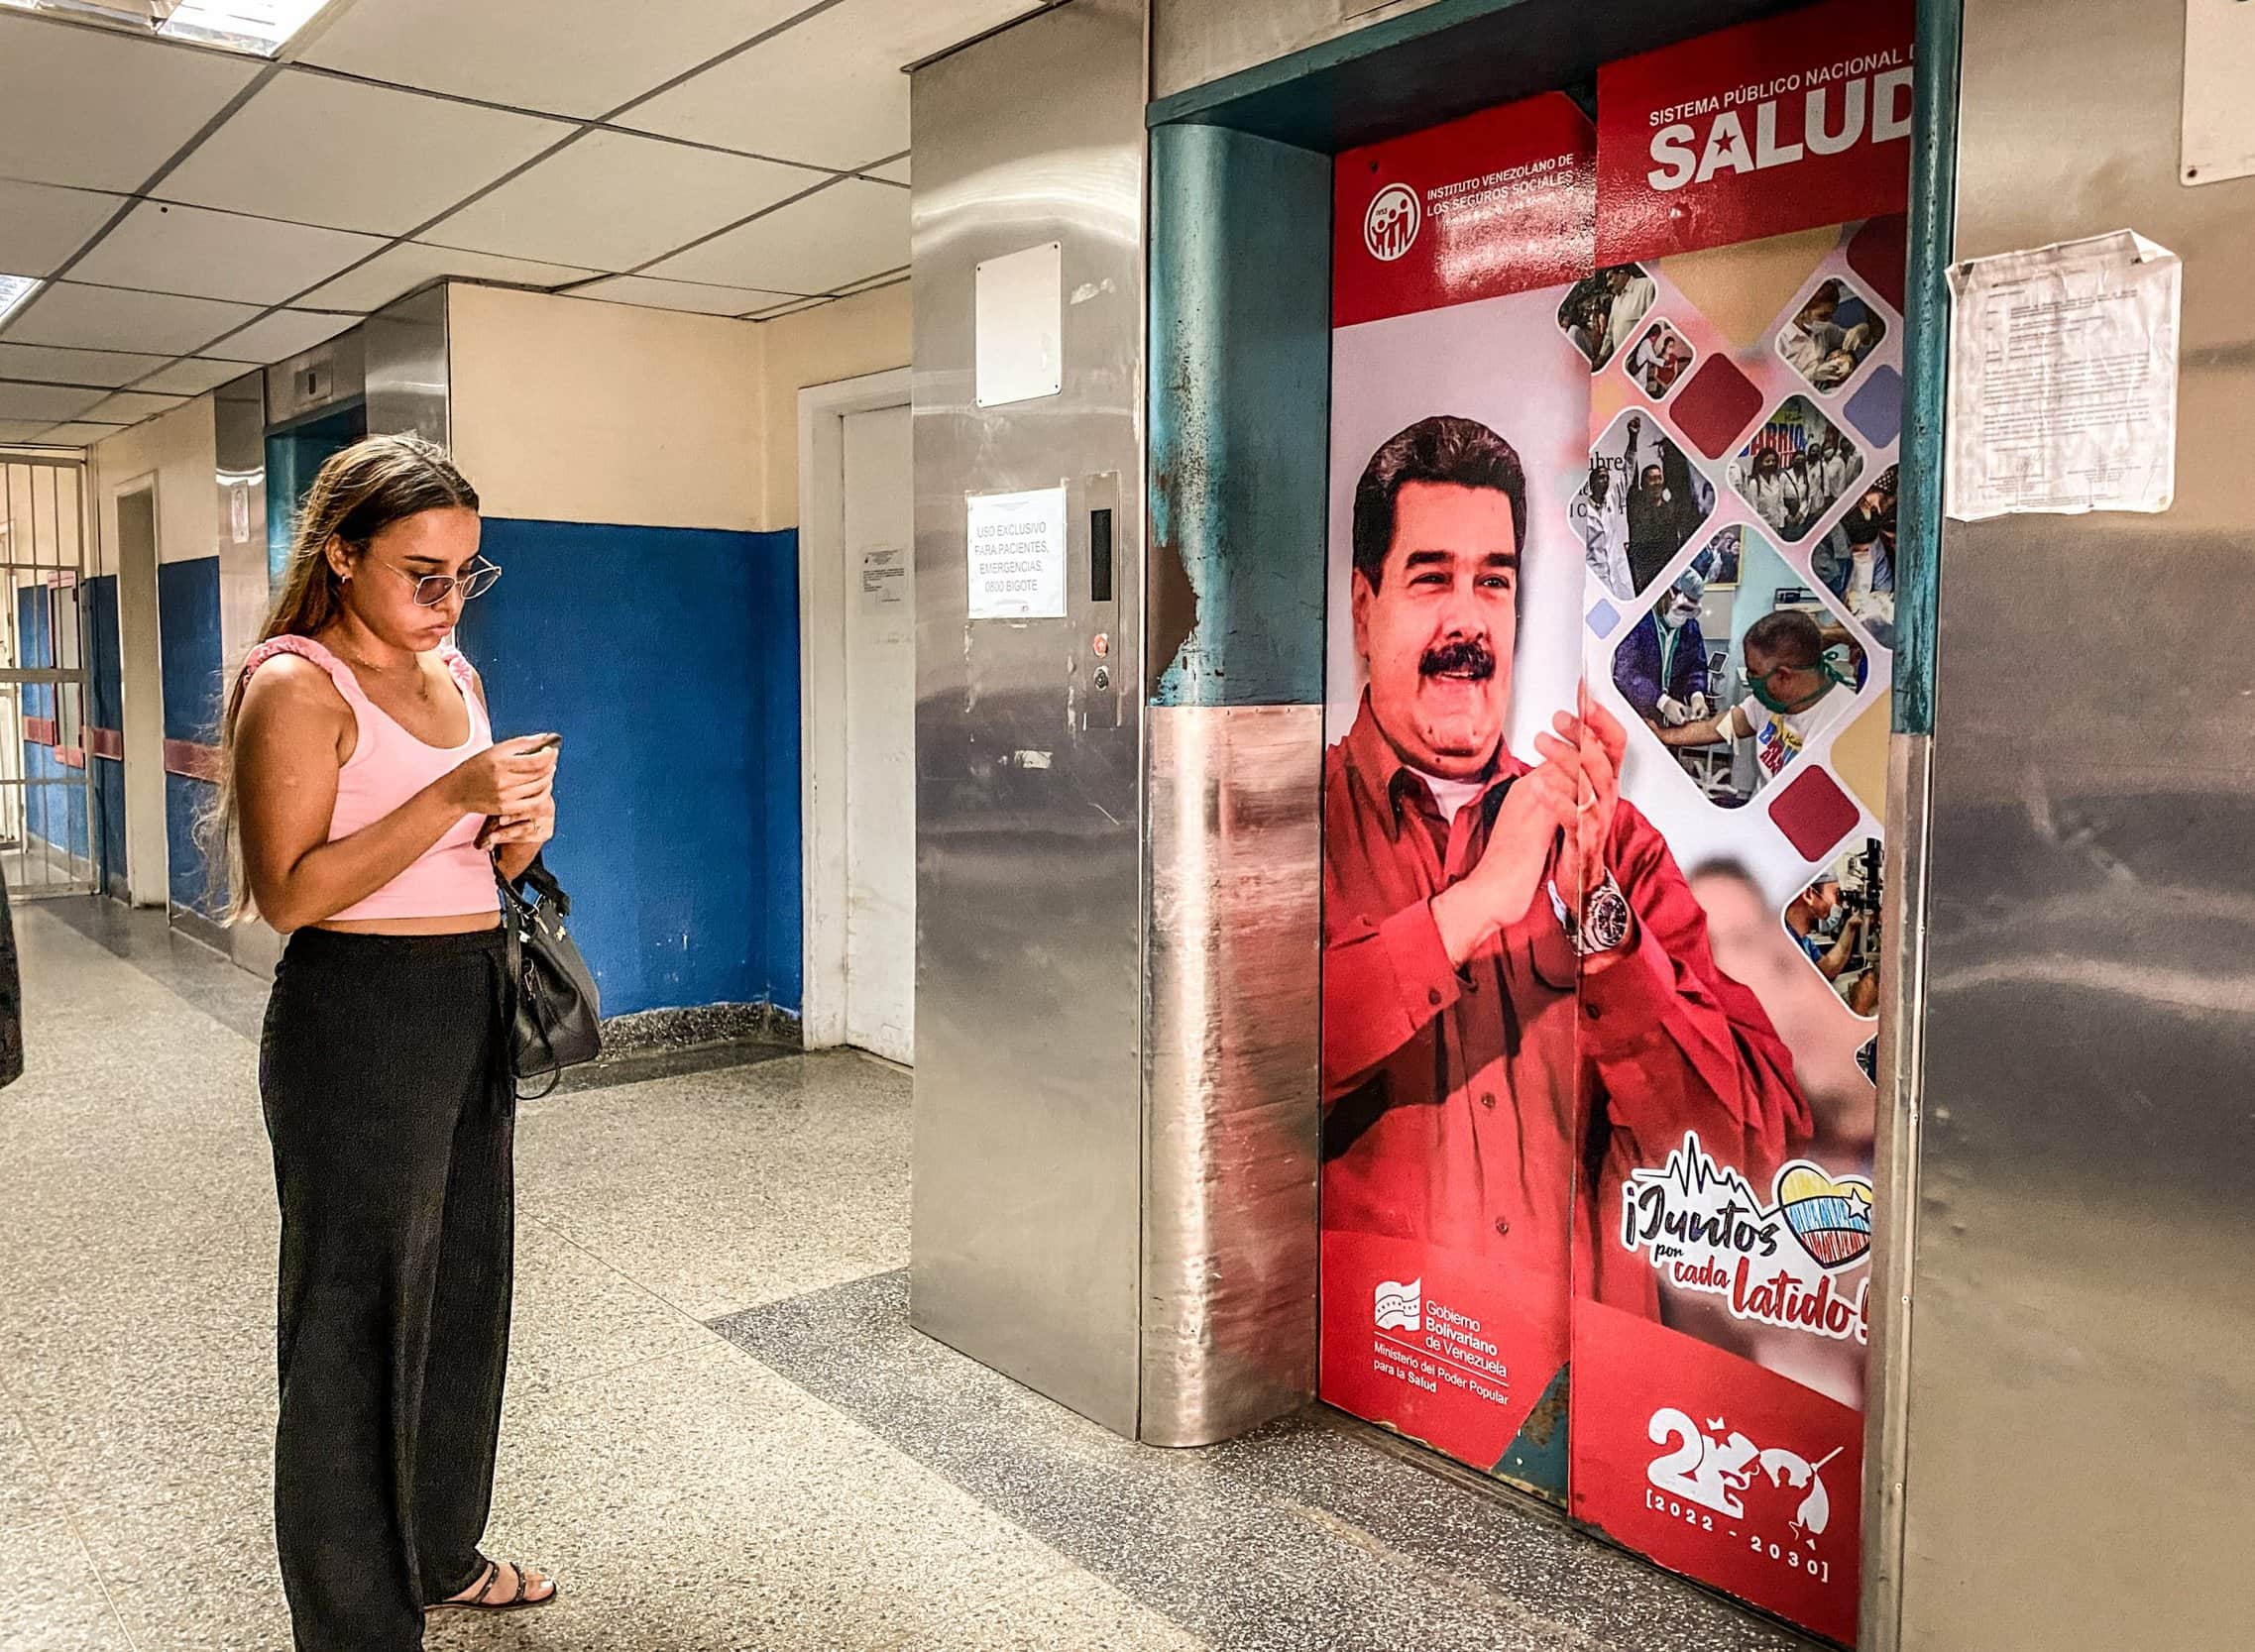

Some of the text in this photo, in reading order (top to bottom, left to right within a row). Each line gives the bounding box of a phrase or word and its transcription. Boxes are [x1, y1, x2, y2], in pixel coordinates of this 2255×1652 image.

[1649, 96, 1720, 127] SISTEMA
[1724, 74, 1801, 107] PÚBLICO
[1805, 49, 1903, 87] NACIONAL
[1647, 65, 1914, 191] SALUD
[1427, 153, 1574, 200] INSTITUTO VENEZOLANO DE
[1427, 202, 1450, 217] LOS
[1452, 187, 1510, 209] SEGUROS
[1512, 169, 1574, 195] SOCIALES
[976, 521, 1047, 538] USO EXCLUSIVO
[974, 544, 997, 556] PARA
[984, 579, 1039, 593] 0800 BIGOTE
[1654, 1243, 1684, 1262] por
[1674, 1256, 1731, 1288] cada
[1425, 1299, 1481, 1333] Gobierno
[1425, 1316, 1498, 1357] Bolivariano
[1374, 1341, 1510, 1405] Ministerio del Poder Popular
[1425, 1335, 1508, 1377] de Venezuela
[1374, 1359, 1437, 1394] para la Salud
